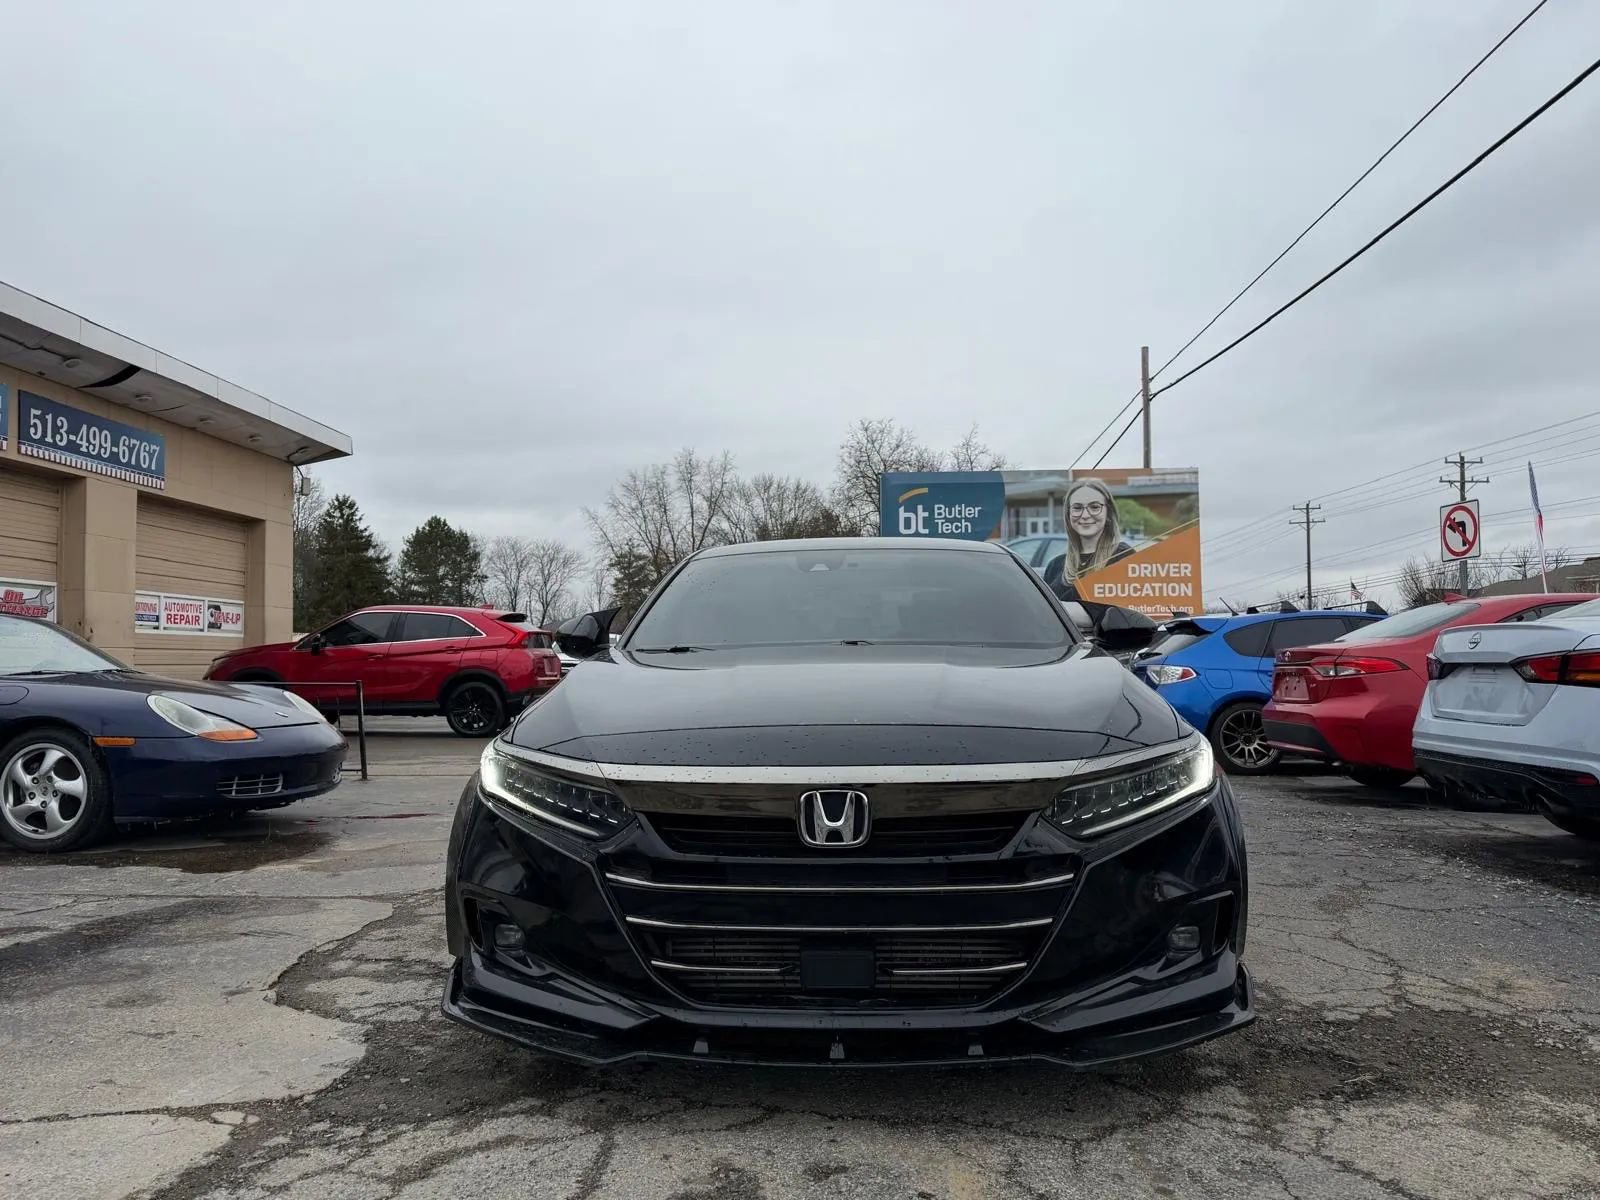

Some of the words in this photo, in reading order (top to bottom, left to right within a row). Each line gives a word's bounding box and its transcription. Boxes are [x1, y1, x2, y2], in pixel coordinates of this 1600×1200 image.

[29, 407, 160, 470] 513-499-6767
[934, 504, 982, 518] Butler
[934, 519, 972, 533] Tech
[1127, 563, 1192, 577] DRIVER
[1093, 582, 1193, 597] EDUCATION
[164, 602, 203, 614] AUTOMOTIVE
[166, 613, 201, 626] REPAIR
